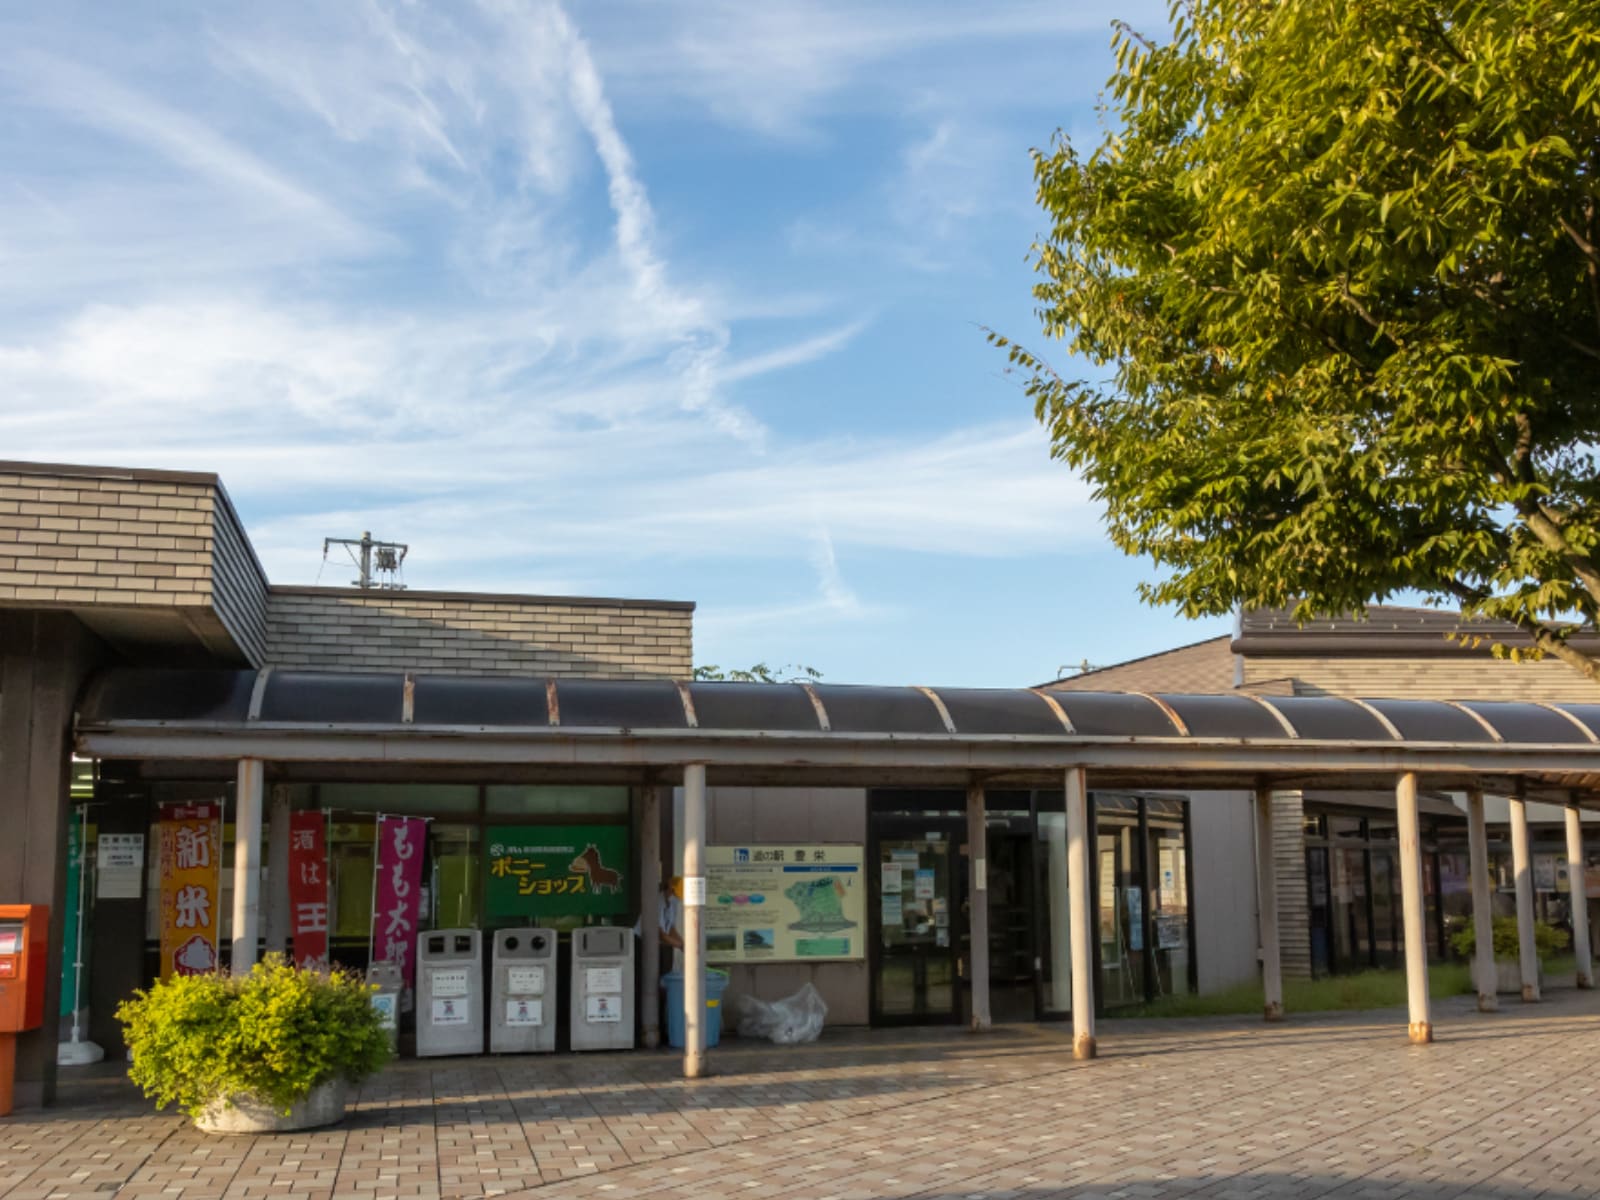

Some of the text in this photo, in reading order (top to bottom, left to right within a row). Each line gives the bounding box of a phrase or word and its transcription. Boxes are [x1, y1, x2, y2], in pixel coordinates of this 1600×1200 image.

[752, 849, 785, 862] 道の駅
[175, 825, 210, 928] 新米
[491, 856, 546, 877] ポニー
[519, 875, 586, 895] ショップ
[386, 825, 414, 968] もも太郎
